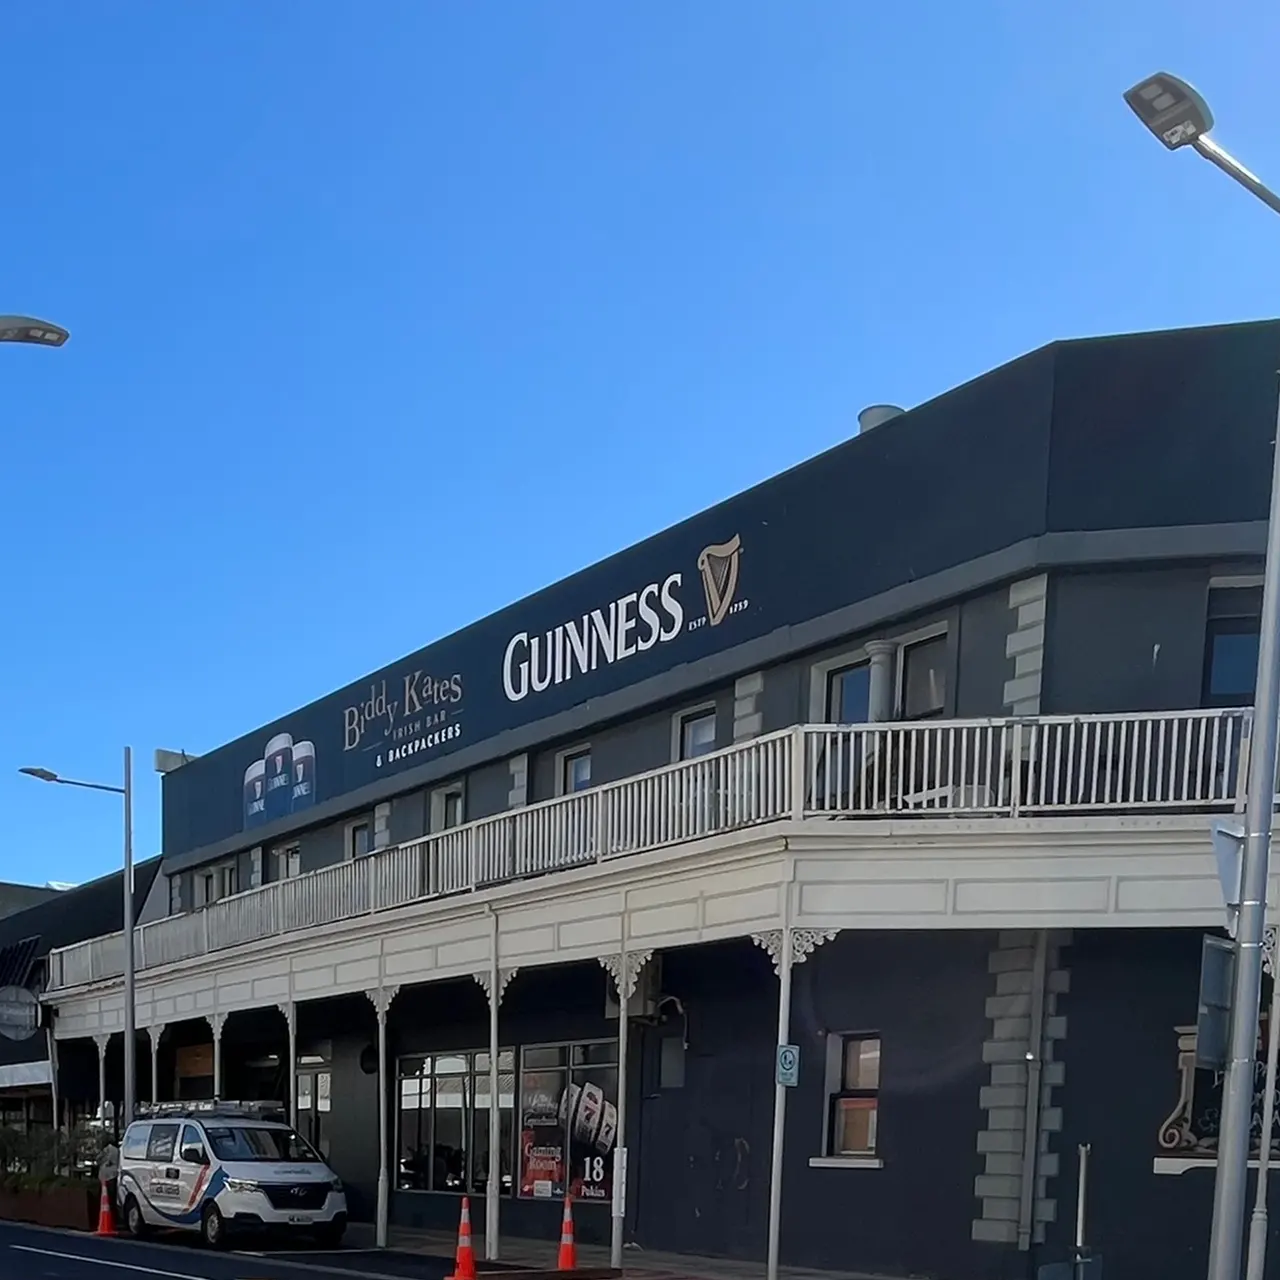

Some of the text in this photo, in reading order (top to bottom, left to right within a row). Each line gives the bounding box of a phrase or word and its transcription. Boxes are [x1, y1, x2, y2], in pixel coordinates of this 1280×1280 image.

[502, 573, 685, 702] GUINNESS
[343, 670, 462, 751] Biddy Kates
[392, 710, 446, 741] IRISH BAR
[388, 723, 461, 763] BACKPACKERS
[525, 1142, 561, 1162] Gaming
[529, 1157, 556, 1171] Room
[583, 1156, 604, 1182] 18
[581, 1185, 606, 1197] Pokies
